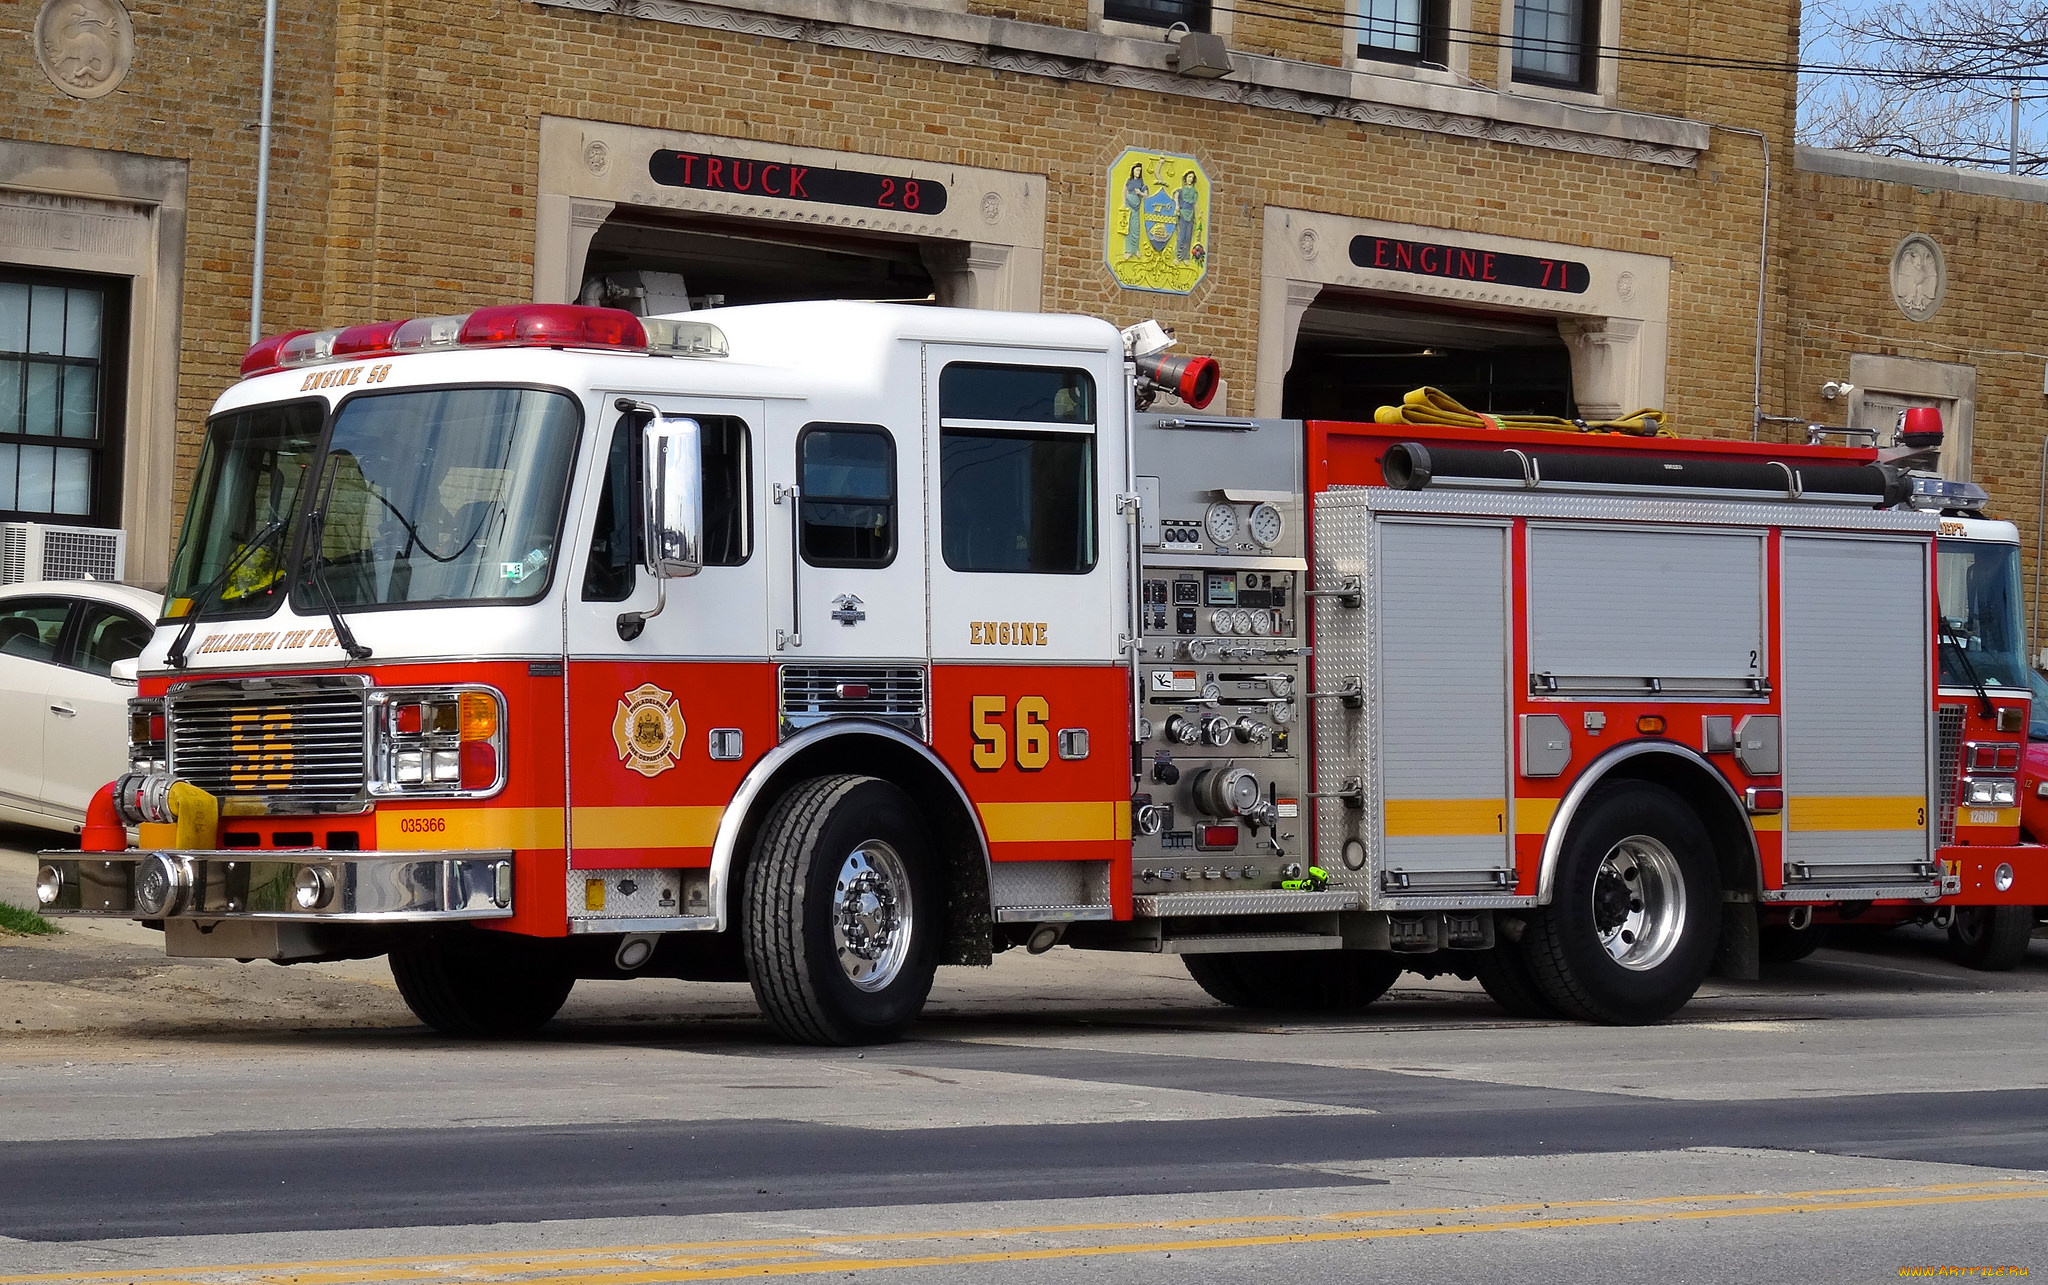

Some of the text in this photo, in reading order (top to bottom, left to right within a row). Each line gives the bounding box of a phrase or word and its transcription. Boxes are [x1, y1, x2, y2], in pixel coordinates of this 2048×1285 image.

[676, 154, 920, 210] TRUCK 28
[1374, 239, 1567, 290] ENGINE 71
[300, 364, 392, 391] ENGINE 56
[196, 631, 281, 654] PHILADELPHIA
[277, 630, 314, 649] FIRE
[970, 621, 1048, 645] ENGINE
[1749, 650, 1757, 668] 2
[629, 698, 669, 714] PHILADELPHIA
[970, 695, 1050, 772] 56
[638, 741, 672, 762] DEPARTMENT
[400, 817, 446, 833] 035366
[1497, 813, 1502, 832] 1
[1917, 807, 1924, 825] 3
[1970, 810, 1998, 823] 126061
